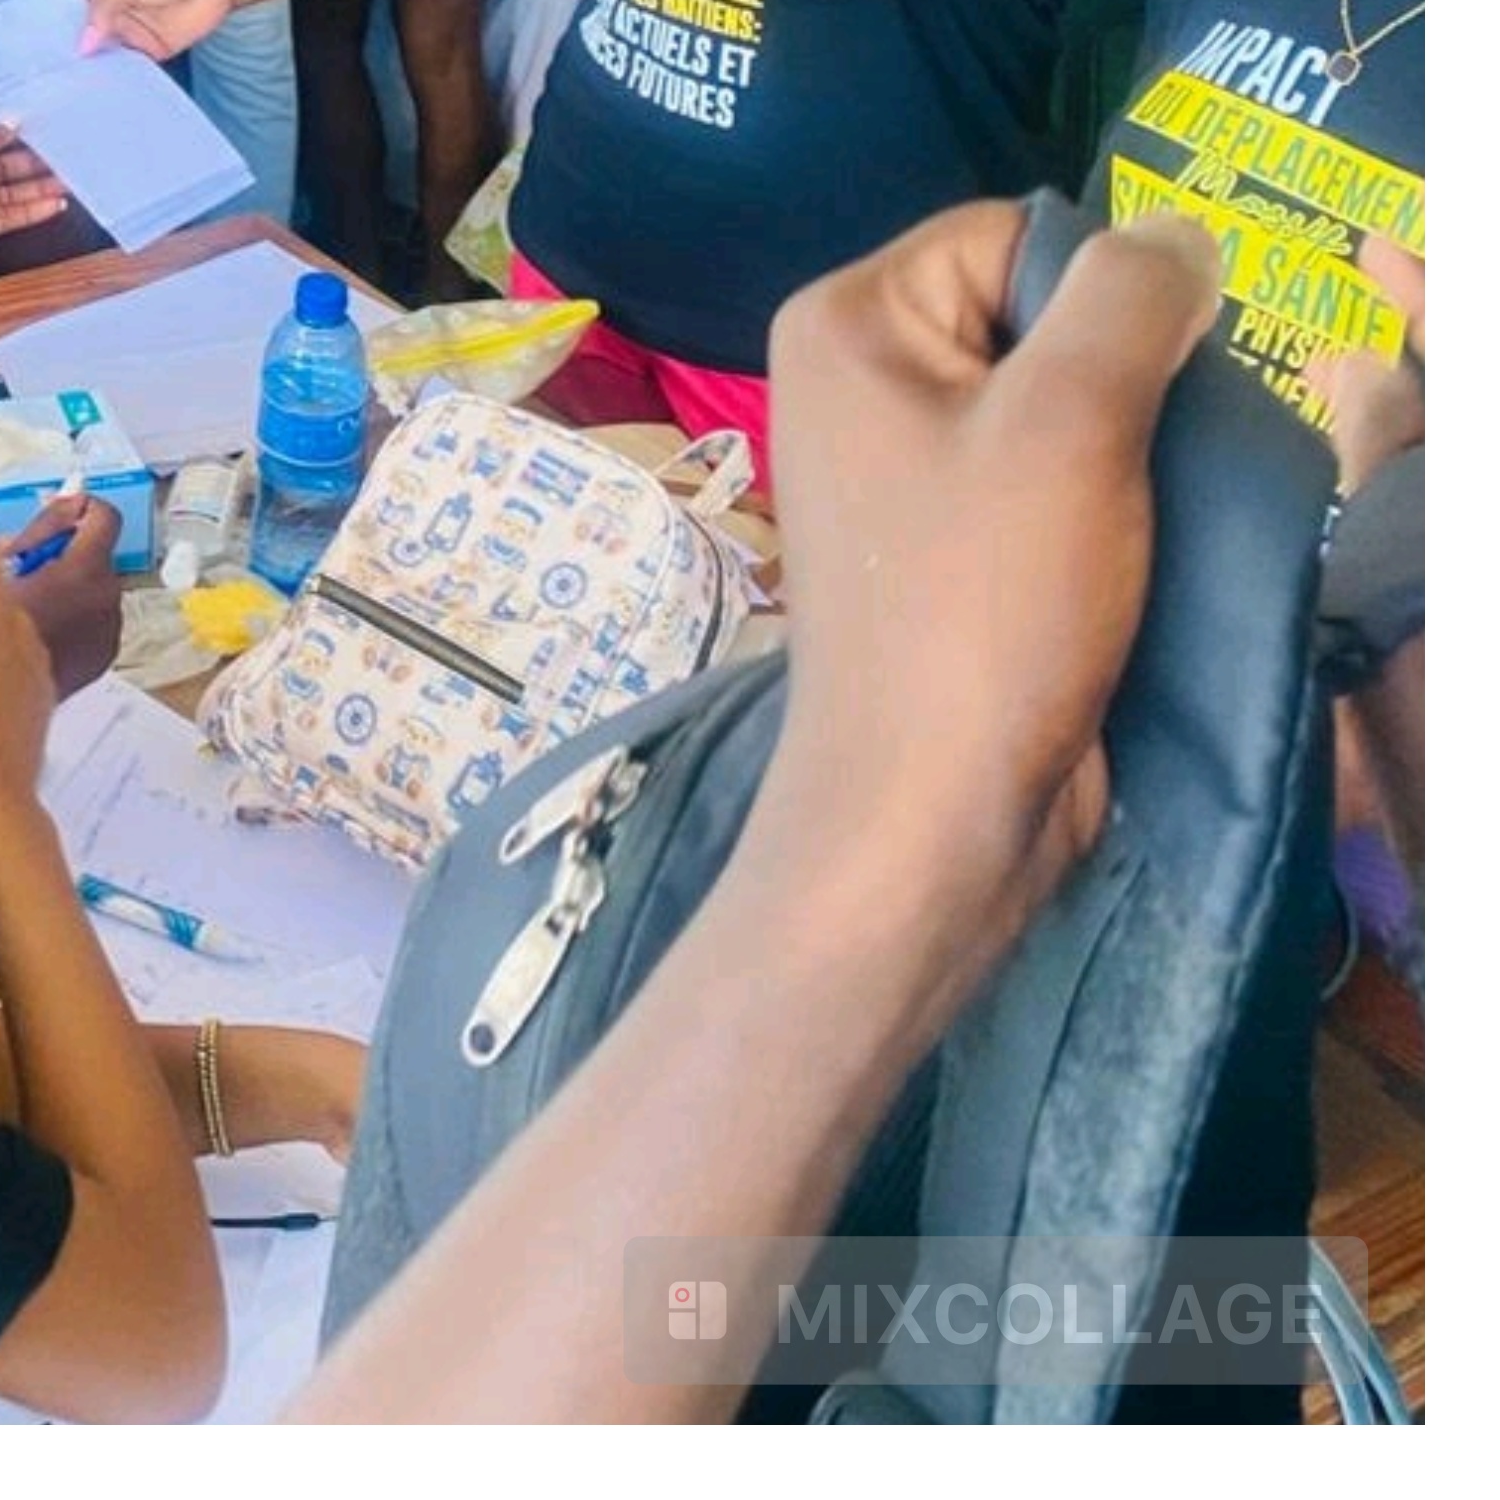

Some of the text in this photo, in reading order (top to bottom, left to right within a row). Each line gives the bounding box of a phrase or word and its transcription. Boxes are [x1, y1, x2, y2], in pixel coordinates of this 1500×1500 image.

[613, 0, 714, 77] ACTUELS
[717, 42, 758, 88] ET
[626, 51, 738, 129] FUTURES
[1135, 80, 1425, 254] DU DEPLACEMEN
